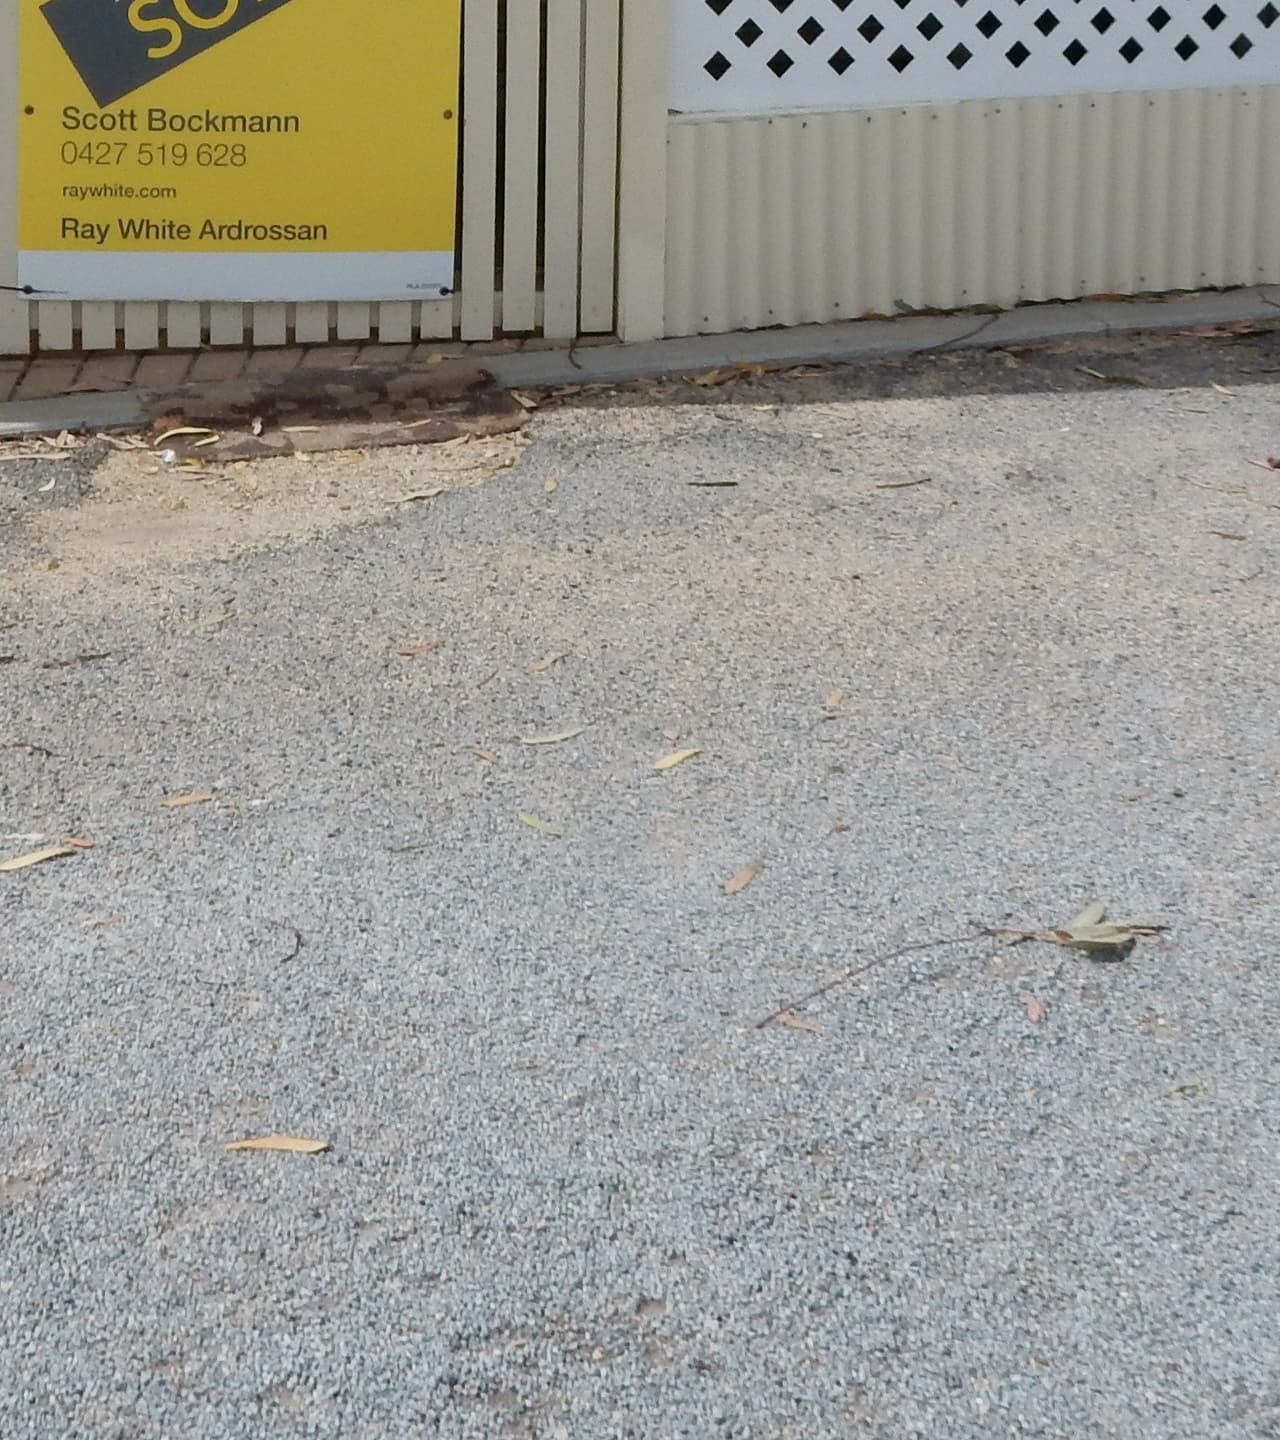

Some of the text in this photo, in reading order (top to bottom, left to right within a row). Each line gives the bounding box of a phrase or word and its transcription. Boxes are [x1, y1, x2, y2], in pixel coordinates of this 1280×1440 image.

[62, 106, 300, 133] Scott Bockmann
[61, 140, 247, 167] 0427 519 628
[62, 183, 177, 201] raywhite.com
[60, 217, 328, 245] Ray White Ardrossan
